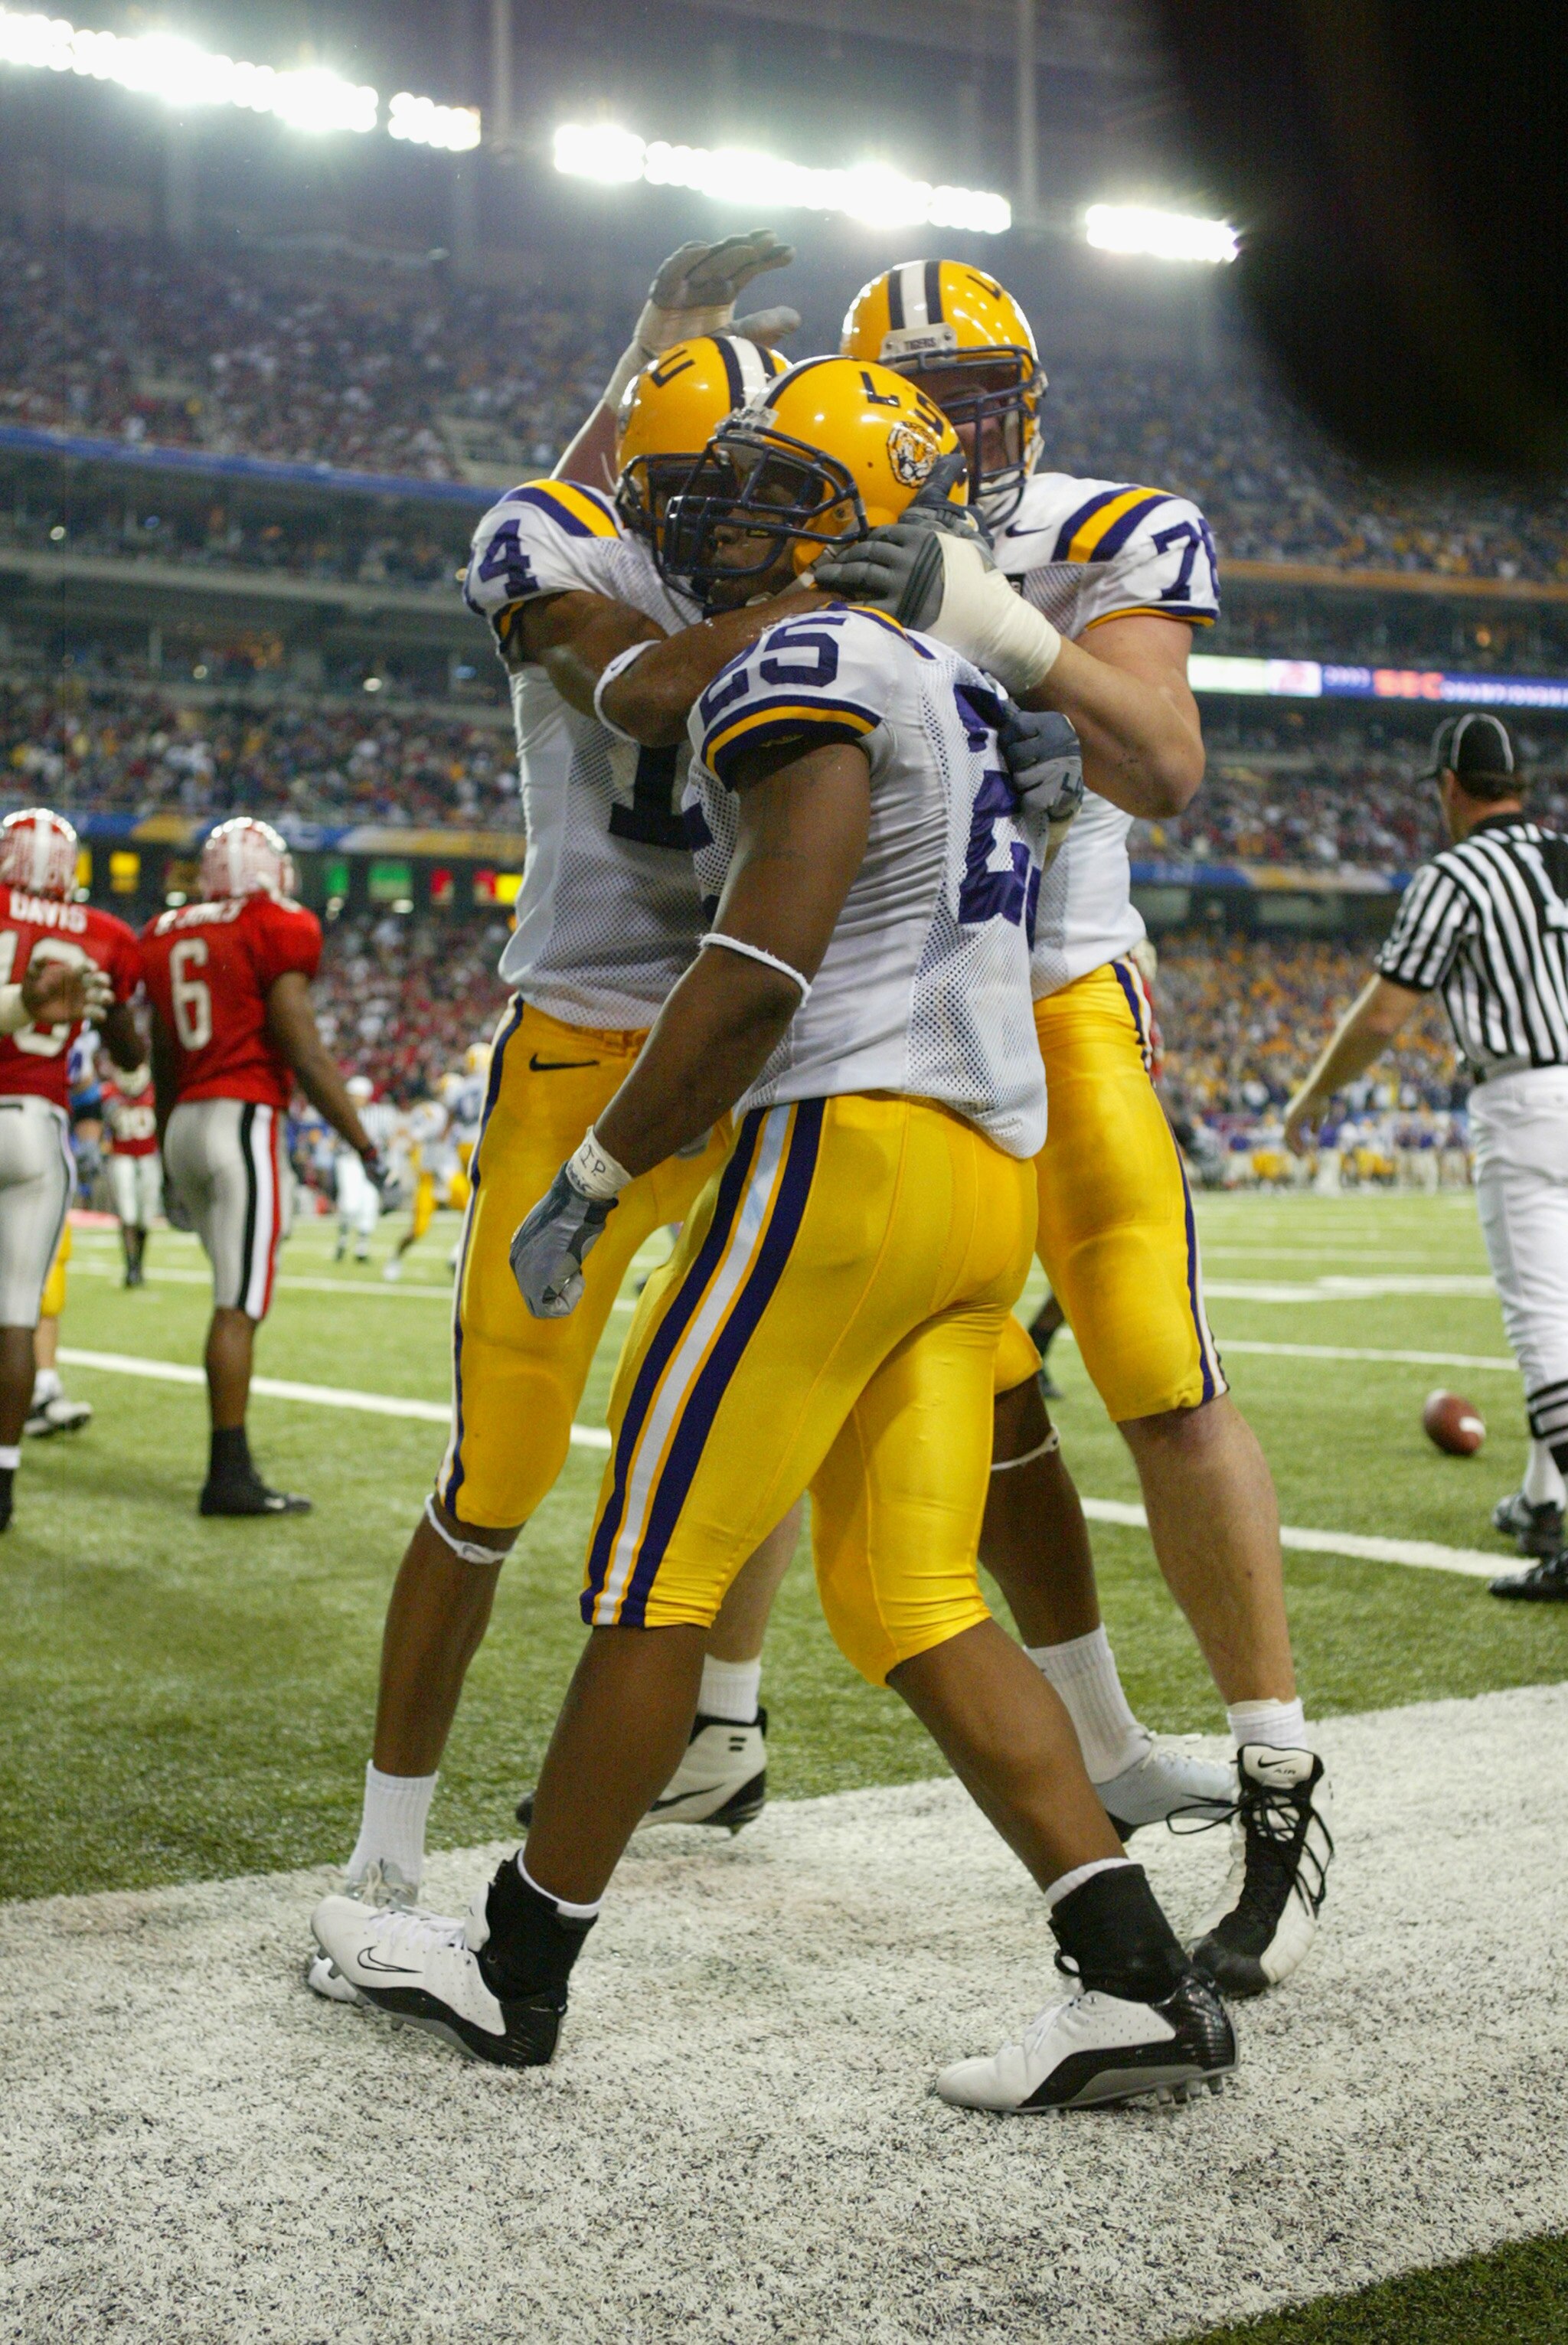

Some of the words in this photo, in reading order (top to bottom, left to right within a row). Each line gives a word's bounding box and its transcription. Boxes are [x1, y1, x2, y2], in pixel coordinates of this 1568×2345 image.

[904, 337, 936, 352] TIGERS
[699, 616, 847, 732] 25
[952, 683, 1041, 952] 2
[9, 889, 88, 934] DAVIS
[169, 936, 212, 1051] 6
